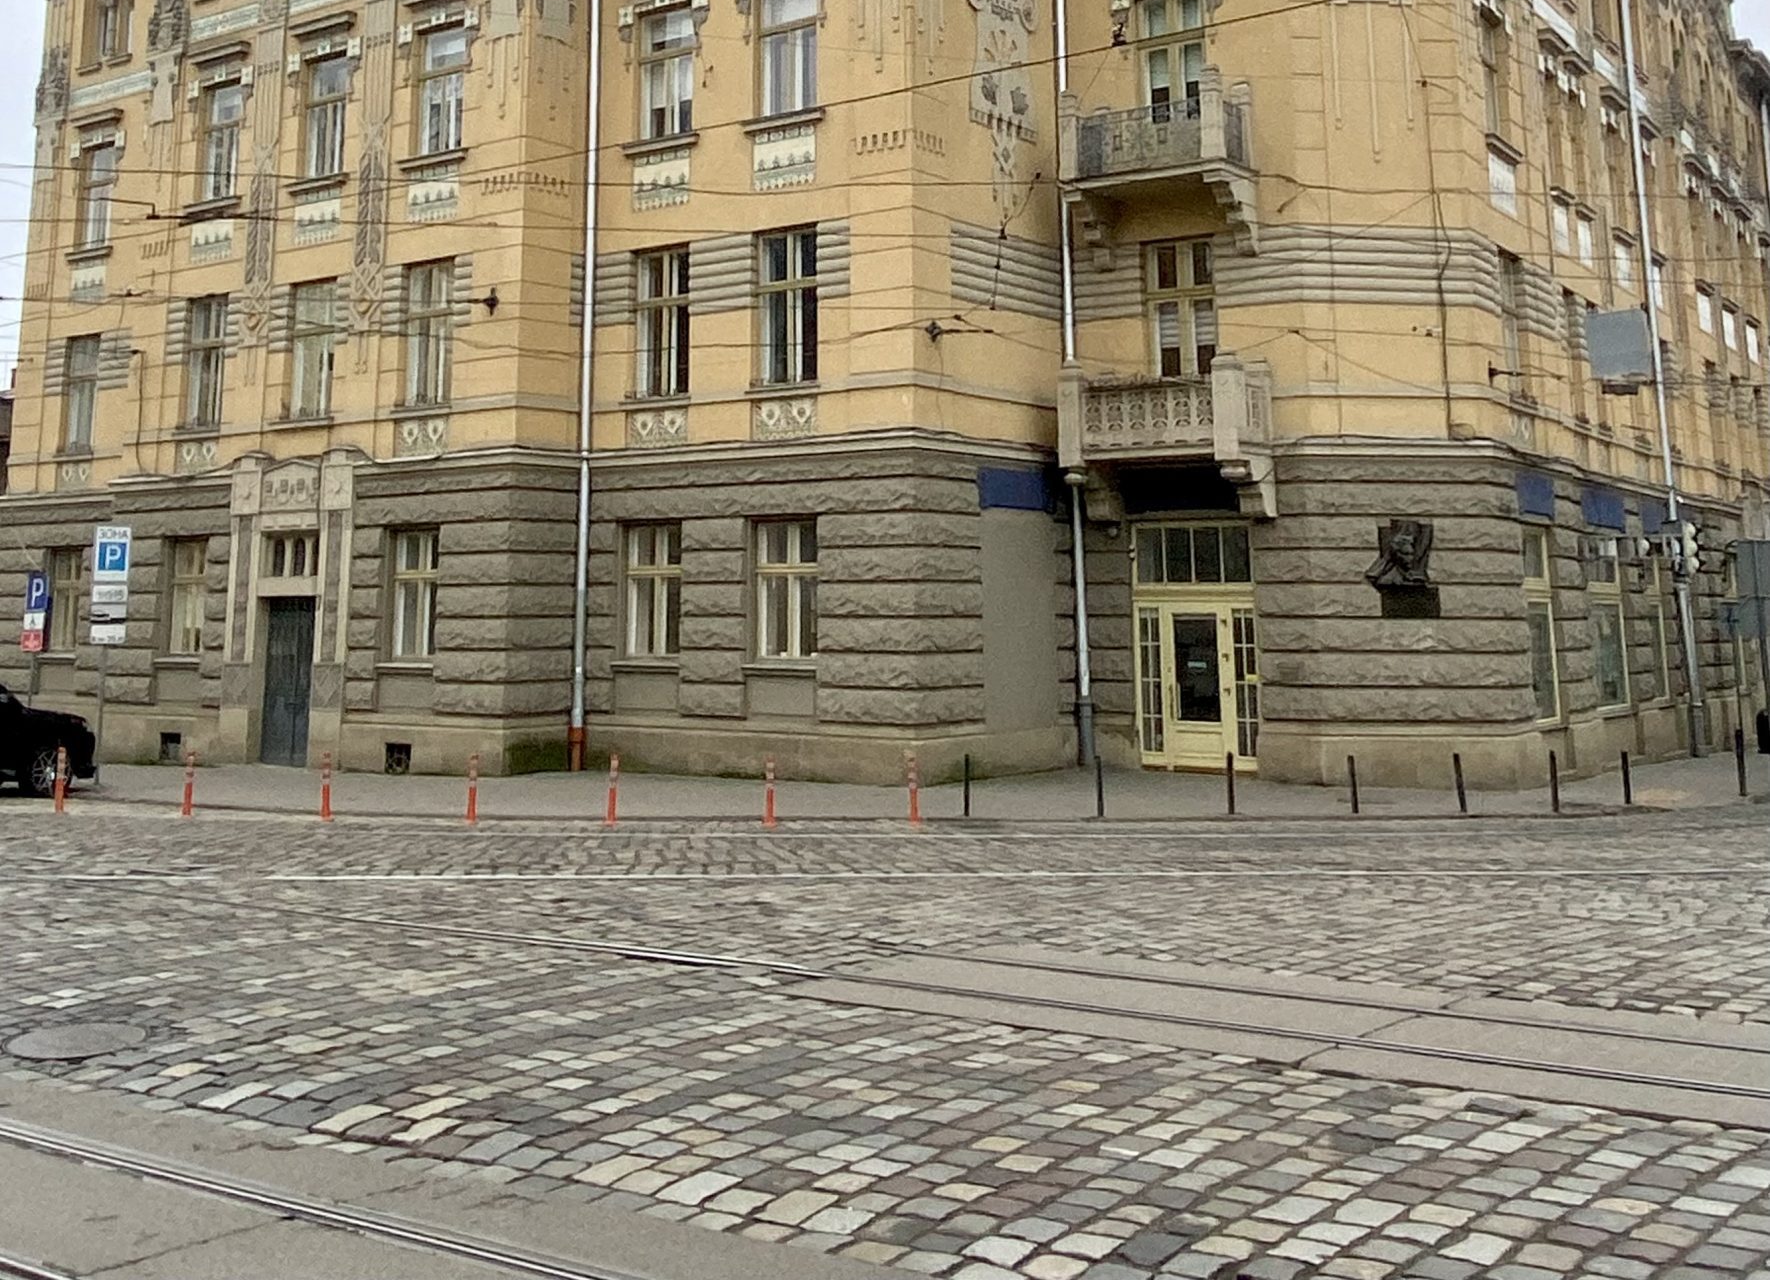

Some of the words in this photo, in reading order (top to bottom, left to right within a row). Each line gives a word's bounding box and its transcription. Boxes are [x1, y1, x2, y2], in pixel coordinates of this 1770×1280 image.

[98, 528, 129, 540] ЗОНА
[105, 544, 121, 570] P
[31, 578, 44, 608] P
